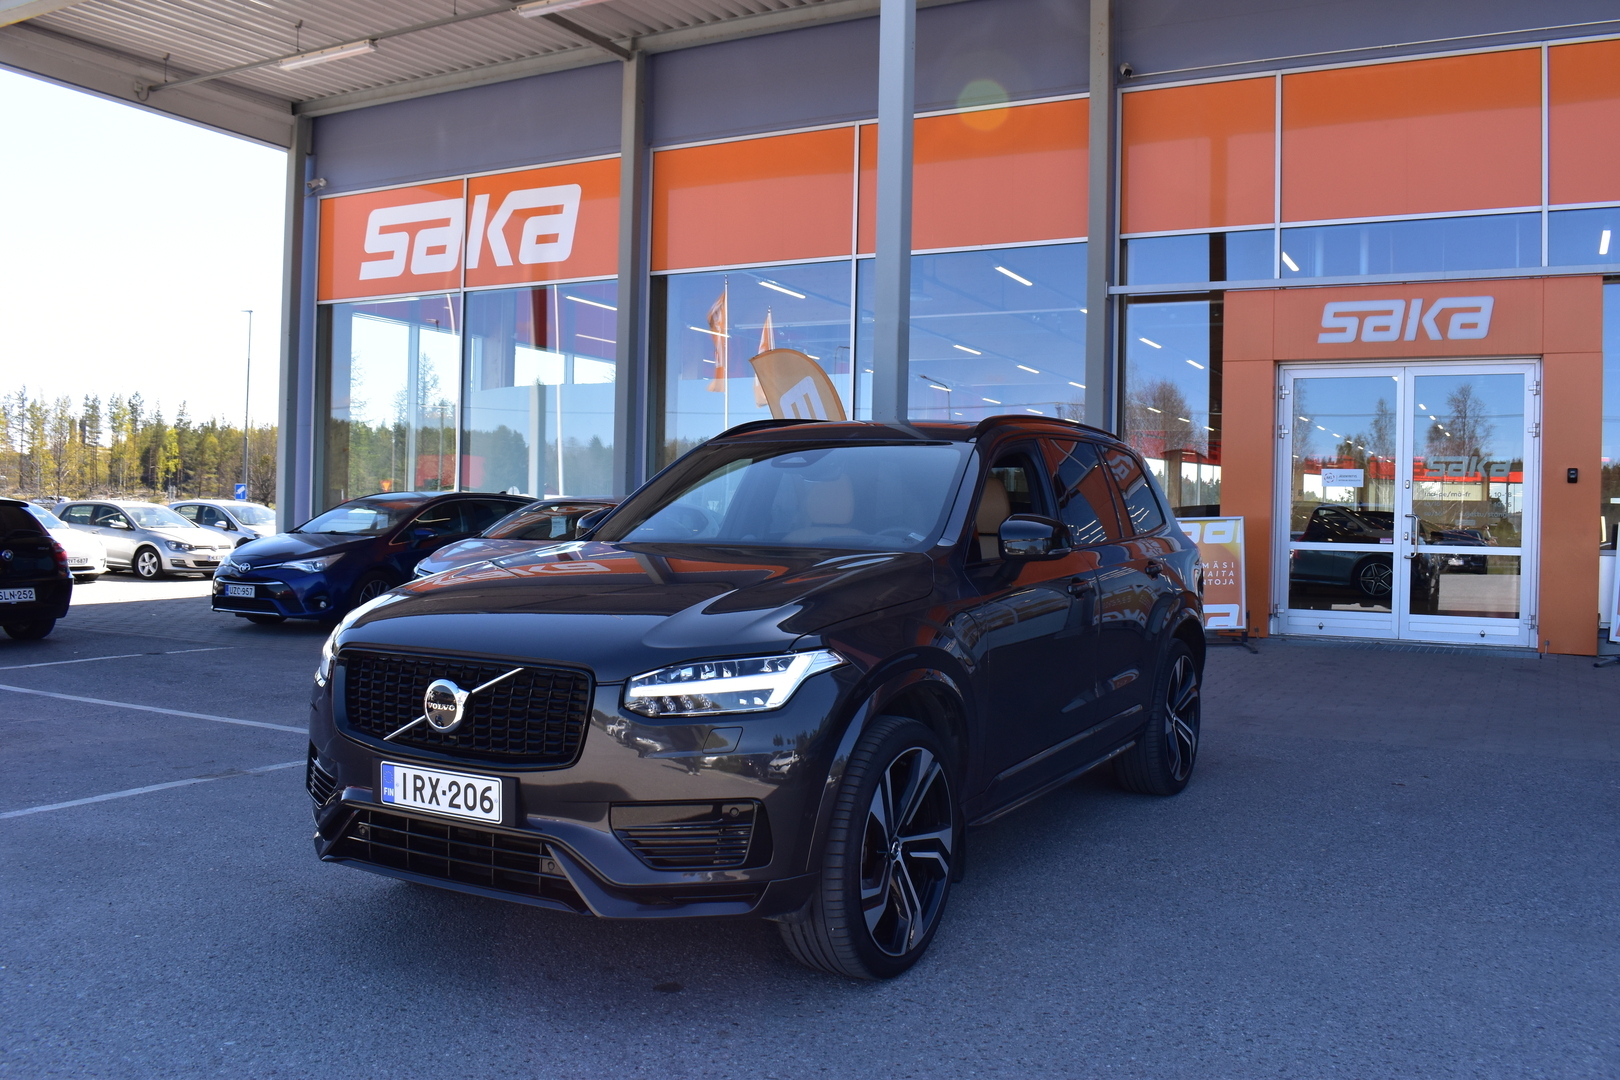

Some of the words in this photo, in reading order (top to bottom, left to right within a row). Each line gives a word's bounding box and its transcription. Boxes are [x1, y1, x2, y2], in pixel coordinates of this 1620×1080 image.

[229, 586, 253, 596] UZC-957
[427, 702, 456, 711] VOLVO
[384, 787, 395, 797] FIN
[402, 772, 494, 814] IRX-206
